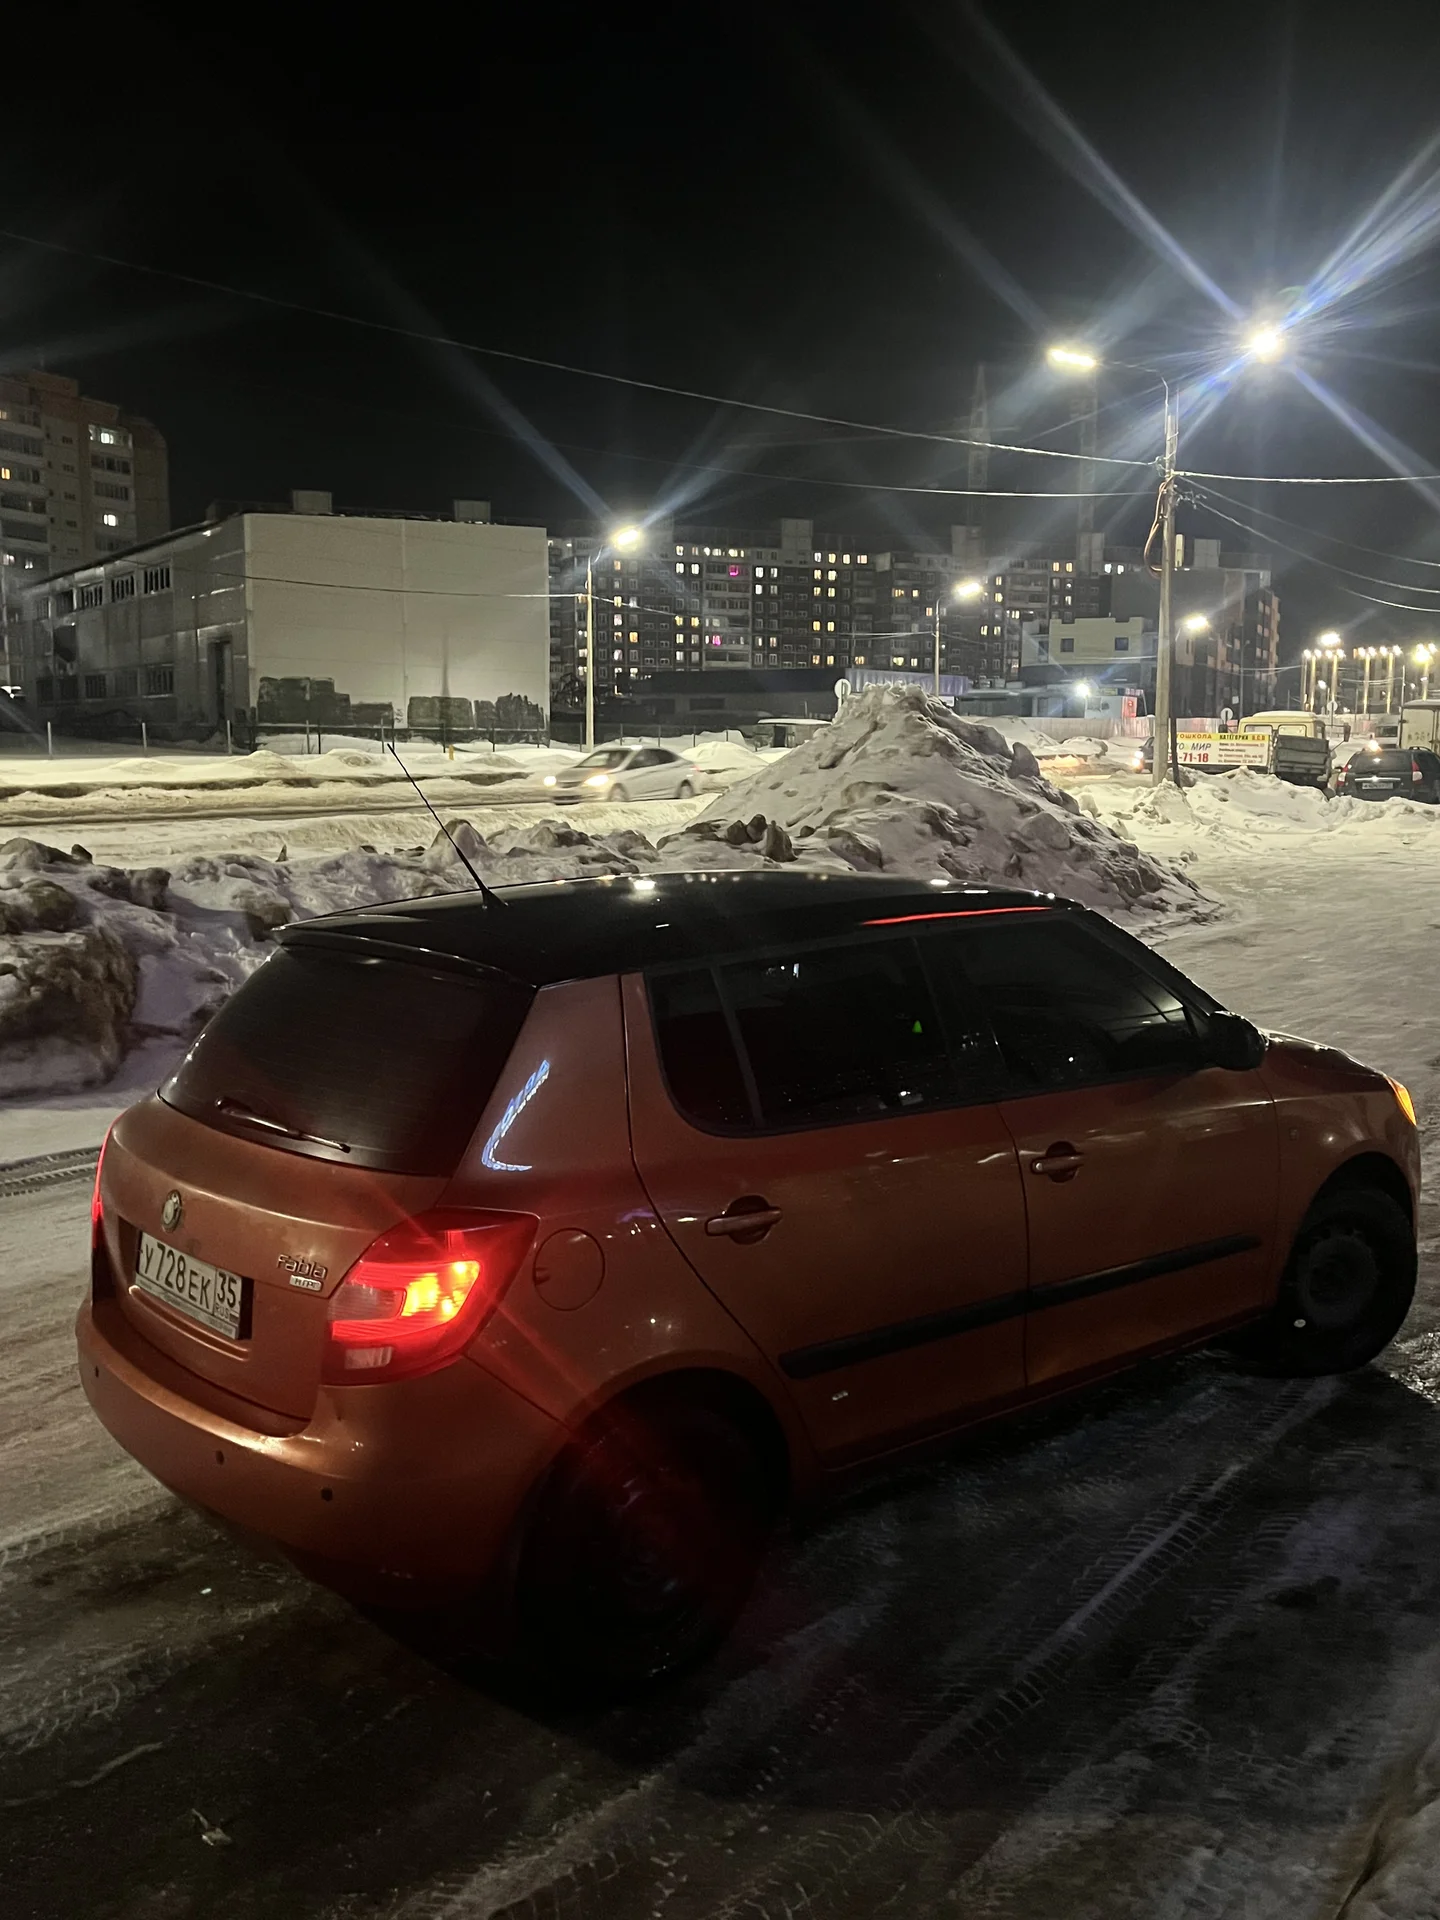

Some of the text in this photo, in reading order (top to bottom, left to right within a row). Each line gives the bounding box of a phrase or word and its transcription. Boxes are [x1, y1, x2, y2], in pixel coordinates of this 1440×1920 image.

[1190, 742, 1212, 751] МИР
[216, 1271, 238, 1309] 35
[214, 1302, 230, 1322] RUS
